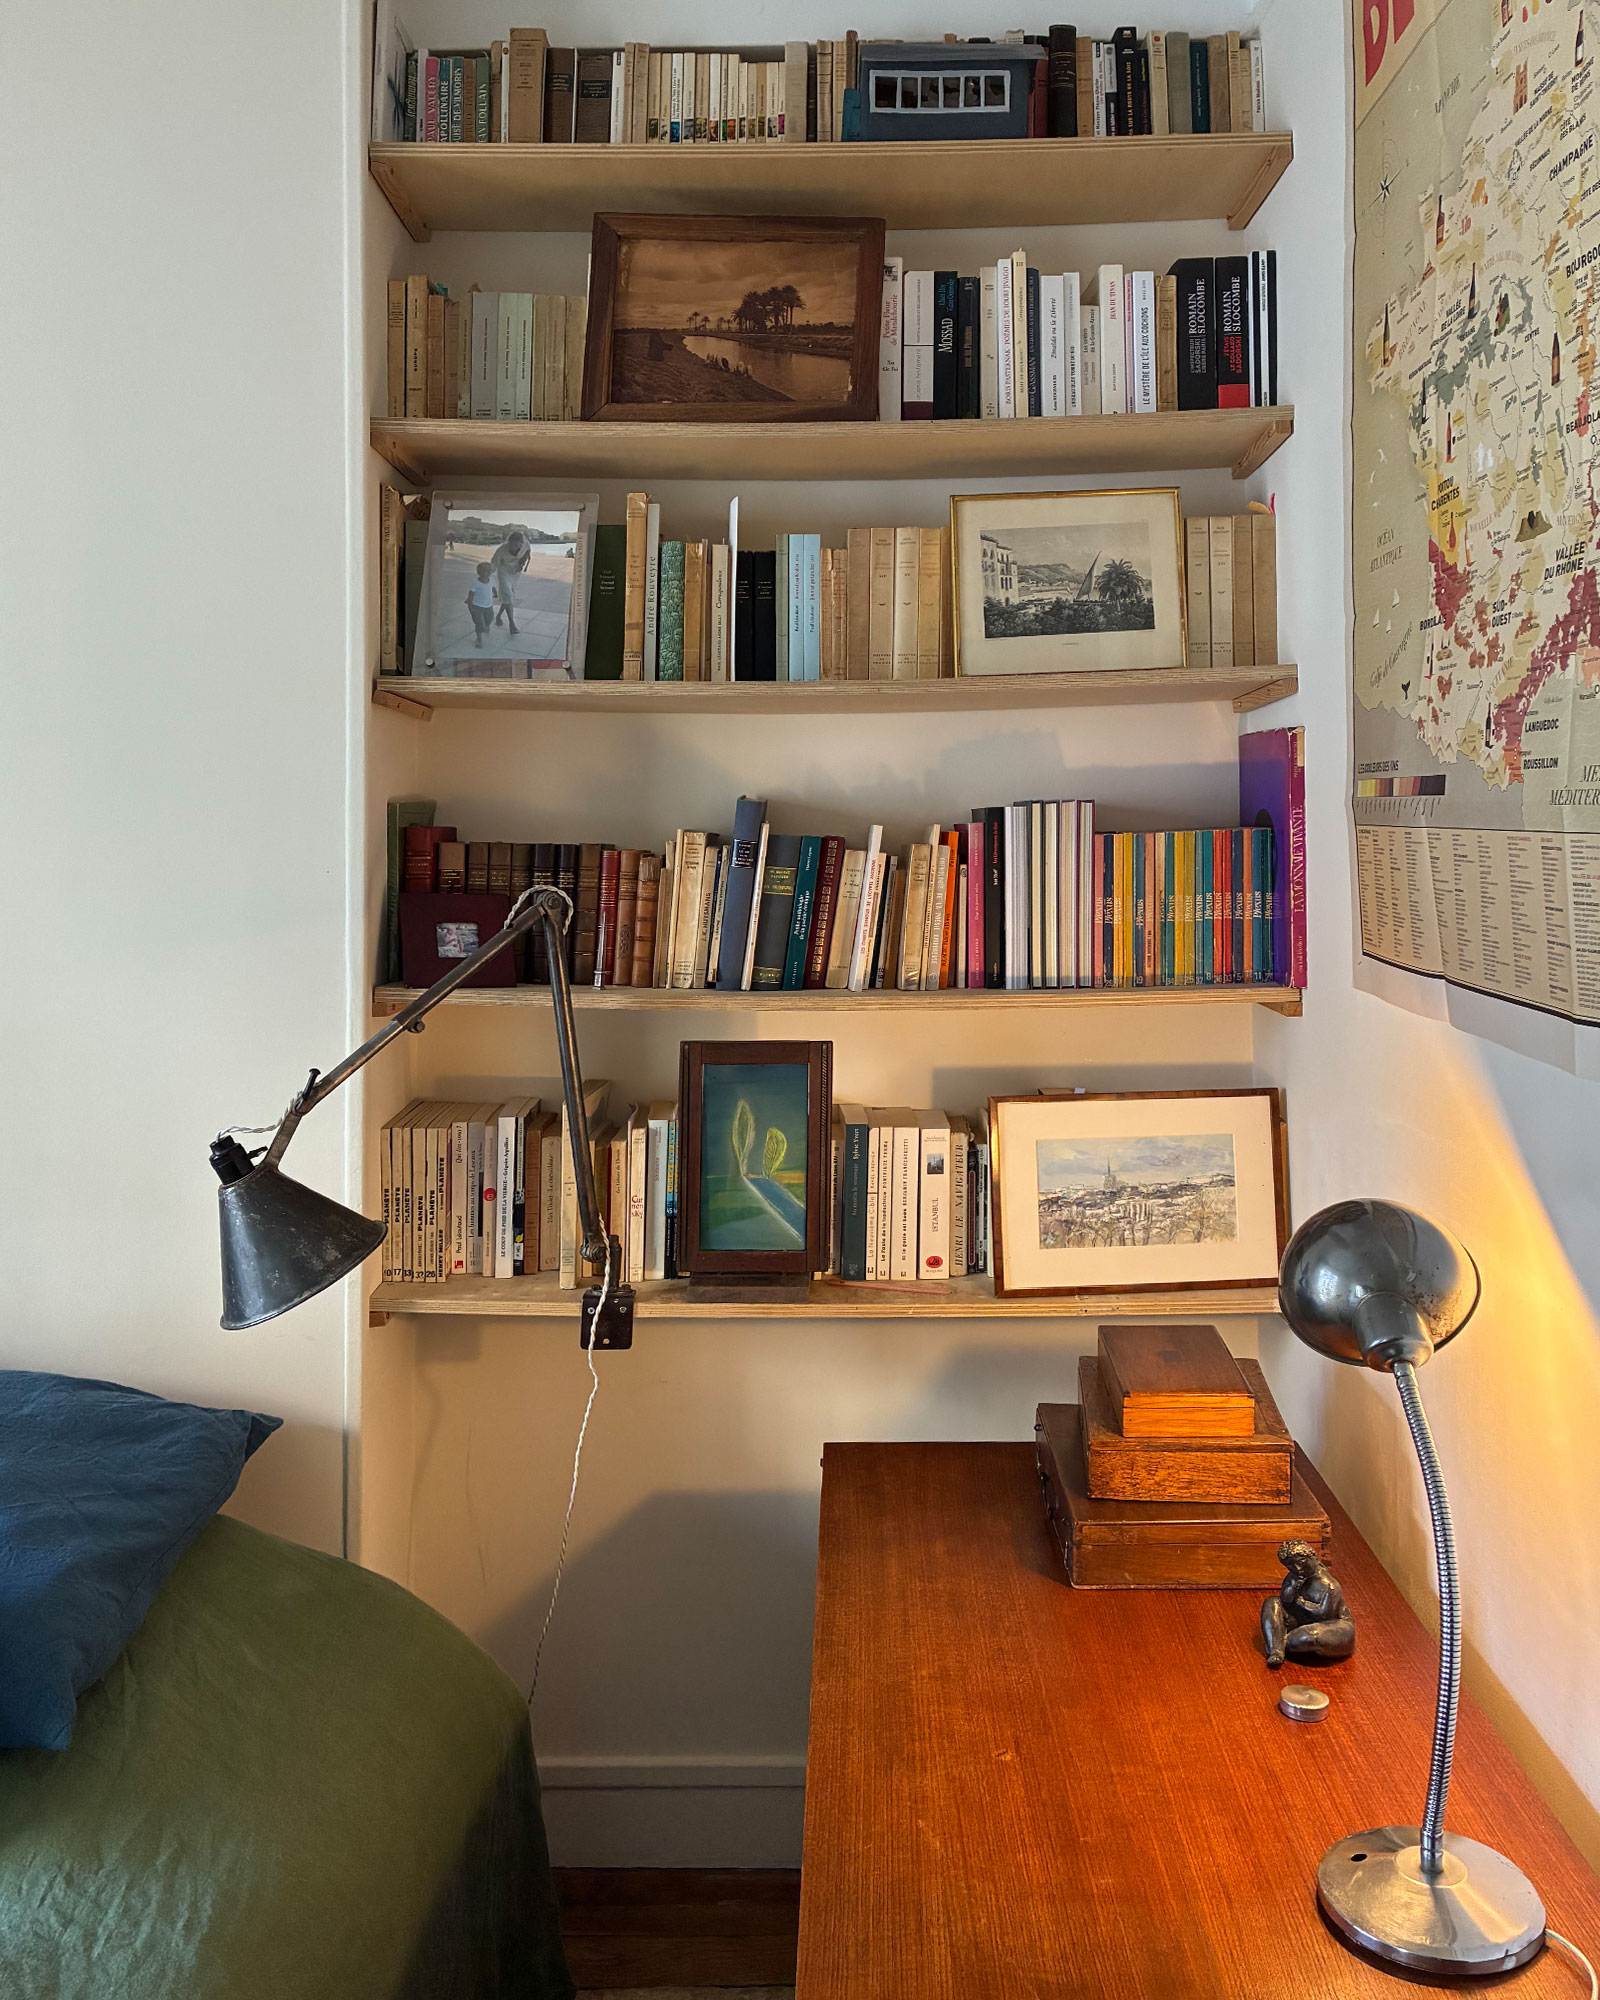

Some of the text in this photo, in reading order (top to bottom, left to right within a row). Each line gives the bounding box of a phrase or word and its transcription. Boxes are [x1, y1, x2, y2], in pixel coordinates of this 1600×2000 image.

[453, 67, 462, 120] DE VILMORIN
[478, 83, 487, 124] FOLLAIN
[440, 81, 449, 142] APOLLINAIRE
[427, 119, 437, 142] PAUL
[1549, 134, 1593, 182] CHAMPAGNE
[1188, 293, 1197, 334] ROMAIN
[1197, 278, 1206, 334] SLOCOMBE
[1223, 291, 1232, 331] ROMAIN
[1232, 276, 1241, 331] SLOCOMBE
[1141, 307, 1149, 333] COCHONS
[938, 318, 953, 353] MOSSAD
[1524, 327, 1540, 343] CENTRE
[1028, 357, 1036, 394] GASSMAN
[1141, 370, 1150, 396] MYSTÈRE
[1555, 541, 1586, 562] VALLÉE
[1544, 558, 1584, 581] DU RHÔNE
[647, 556, 656, 635] André Rouveyre
[1492, 601, 1508, 614] SUD-
[1492, 611, 1512, 627] OUEST
[1524, 719, 1559, 733] LANGUEDOC
[1523, 757, 1559, 770] ROUSSILLON
[1293, 805, 1304, 912] LA MONNAIE VIVANTE
[936, 857, 946, 889] ANTHOLOGIE
[703, 892, 711, 928] HUYSMANS
[1104, 897, 1113, 925] Plexus
[1204, 892, 1212, 919] Plexus
[1214, 892, 1222, 919] Plexus
[1253, 891, 1262, 918] Plexus
[932, 912, 941, 930] POÉSIE
[1207, 972, 1211, 980] 8
[955, 1144, 963, 1266] HENRI LE NAVIGATEUR
[881, 1229, 886, 1237] de
[868, 1250, 874, 1258] La
